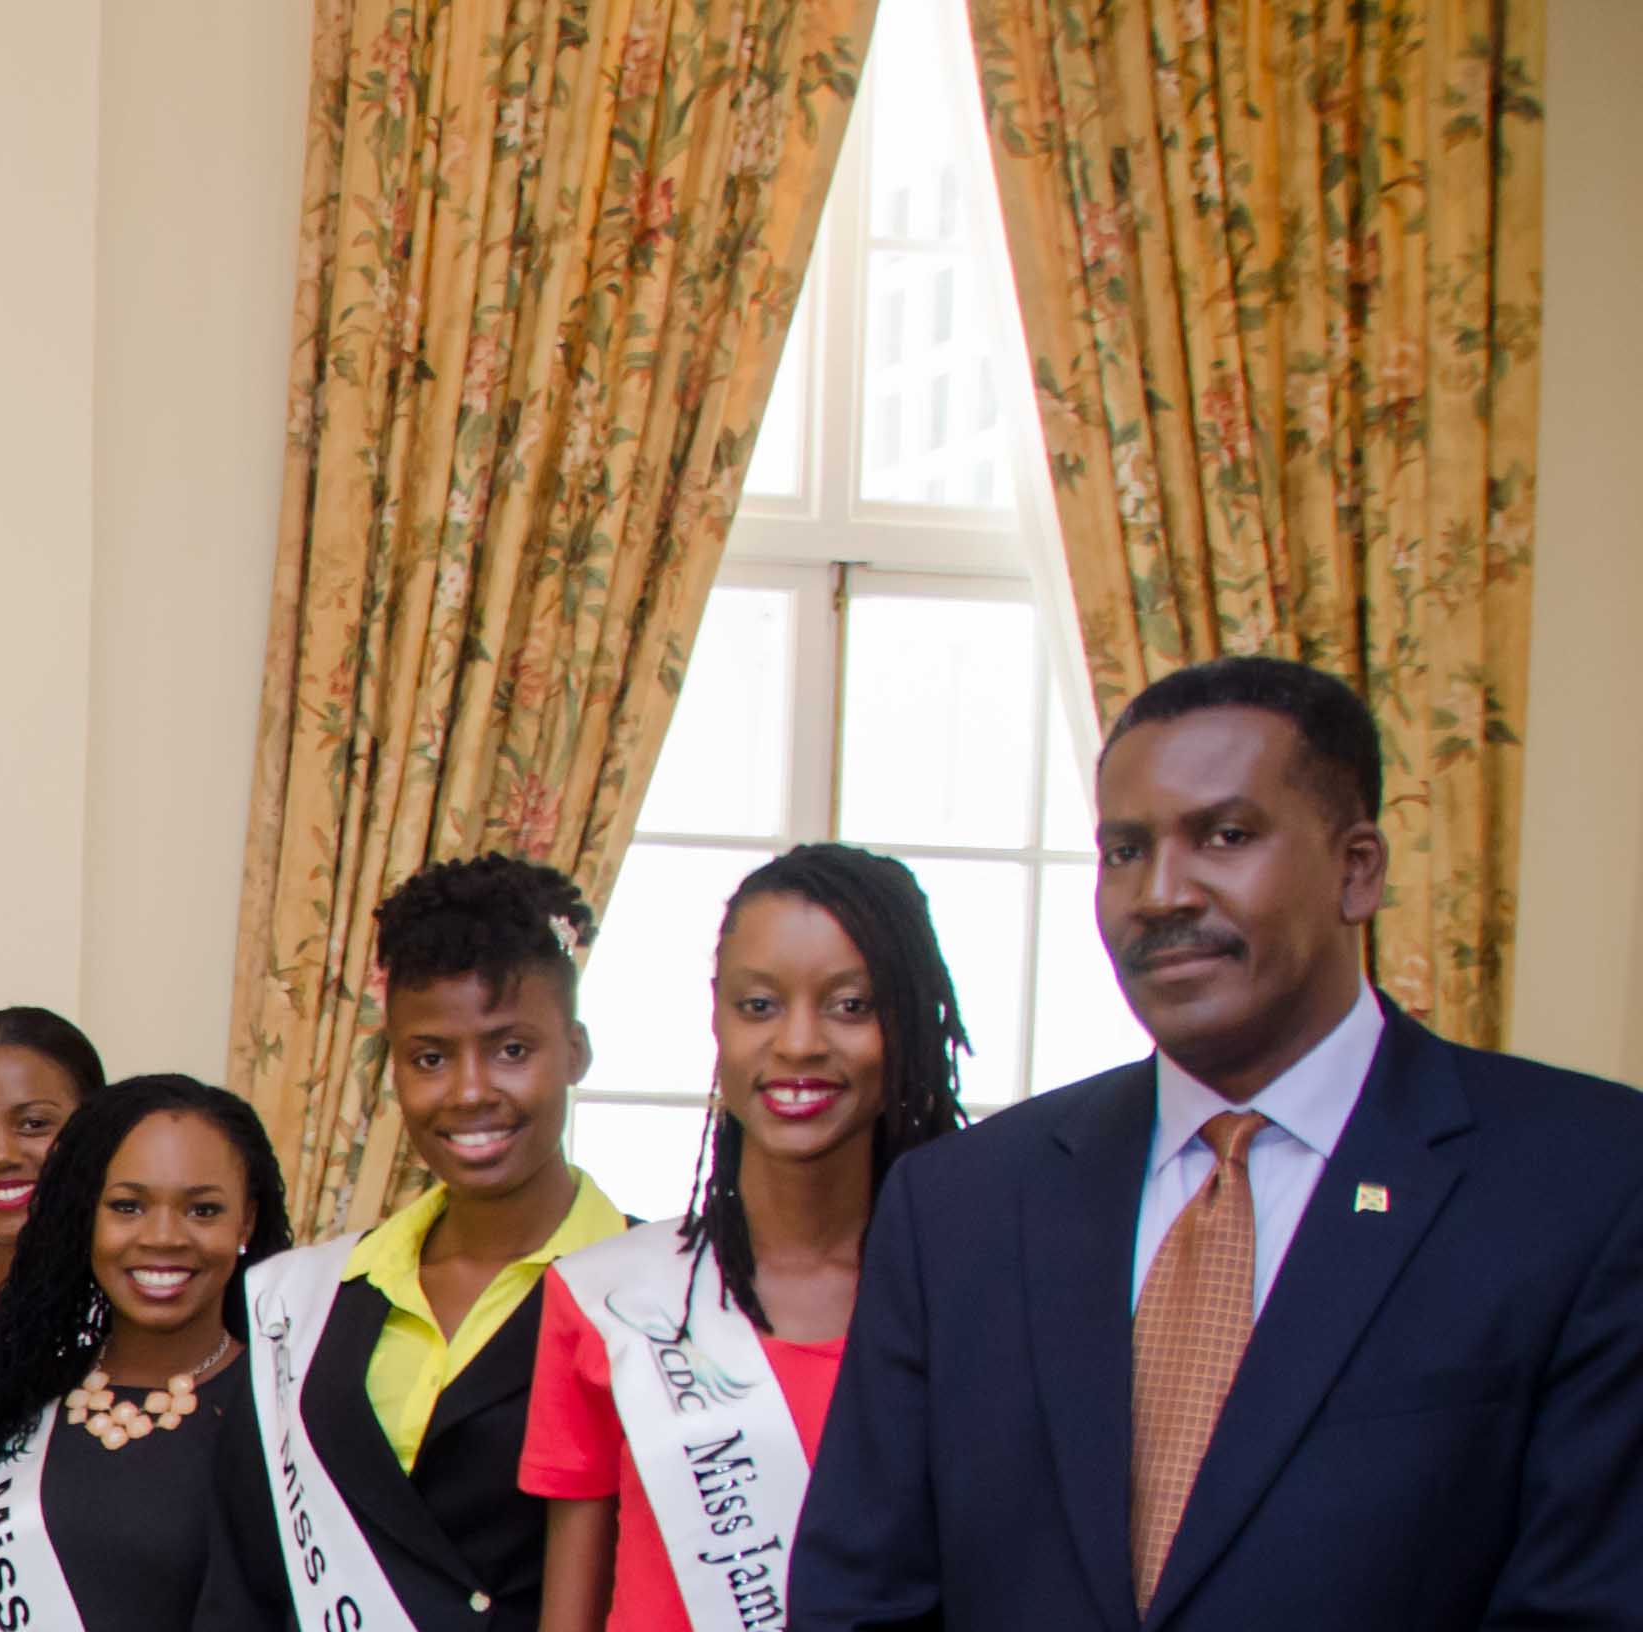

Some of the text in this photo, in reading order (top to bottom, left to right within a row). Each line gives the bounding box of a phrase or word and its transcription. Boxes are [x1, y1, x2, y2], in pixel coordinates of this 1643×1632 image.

[646, 1332, 707, 1412] JCDC
[280, 1429, 326, 1586] Miss
[684, 1429, 757, 1536] Miss
